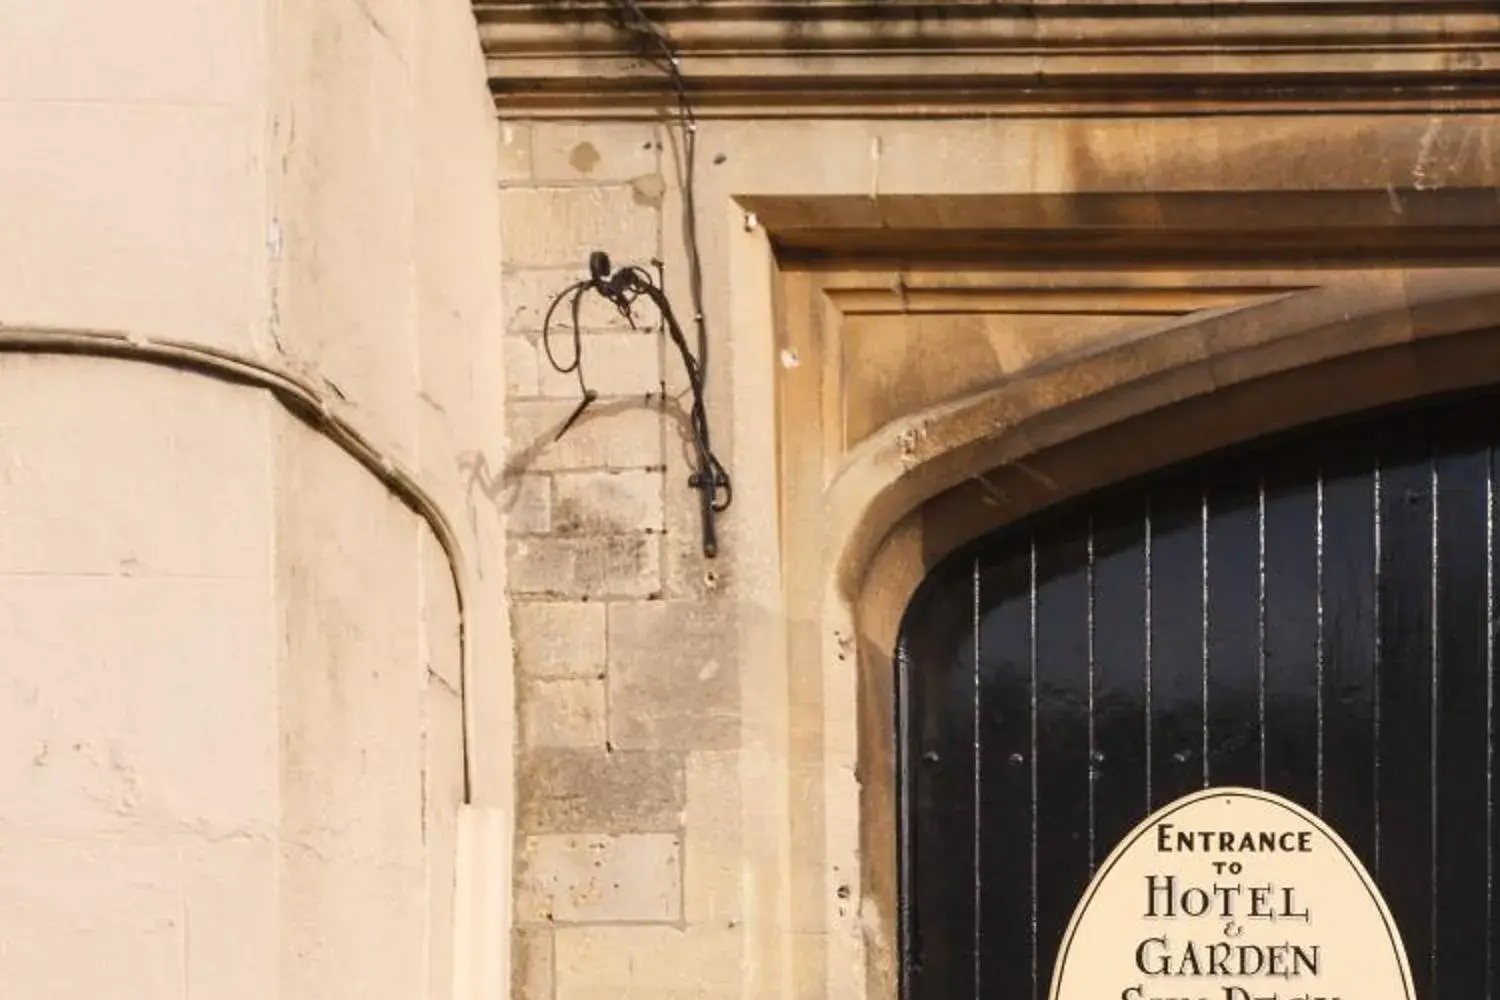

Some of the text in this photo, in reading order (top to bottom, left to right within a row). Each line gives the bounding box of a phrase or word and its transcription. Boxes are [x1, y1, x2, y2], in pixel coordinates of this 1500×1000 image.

[1157, 824, 1313, 852] ENTRANCE
[1212, 861, 1242, 875] TO
[1144, 876, 1311, 921] HOTEL
[1224, 921, 1243, 937] &
[1135, 937, 1320, 978] GARDEN
